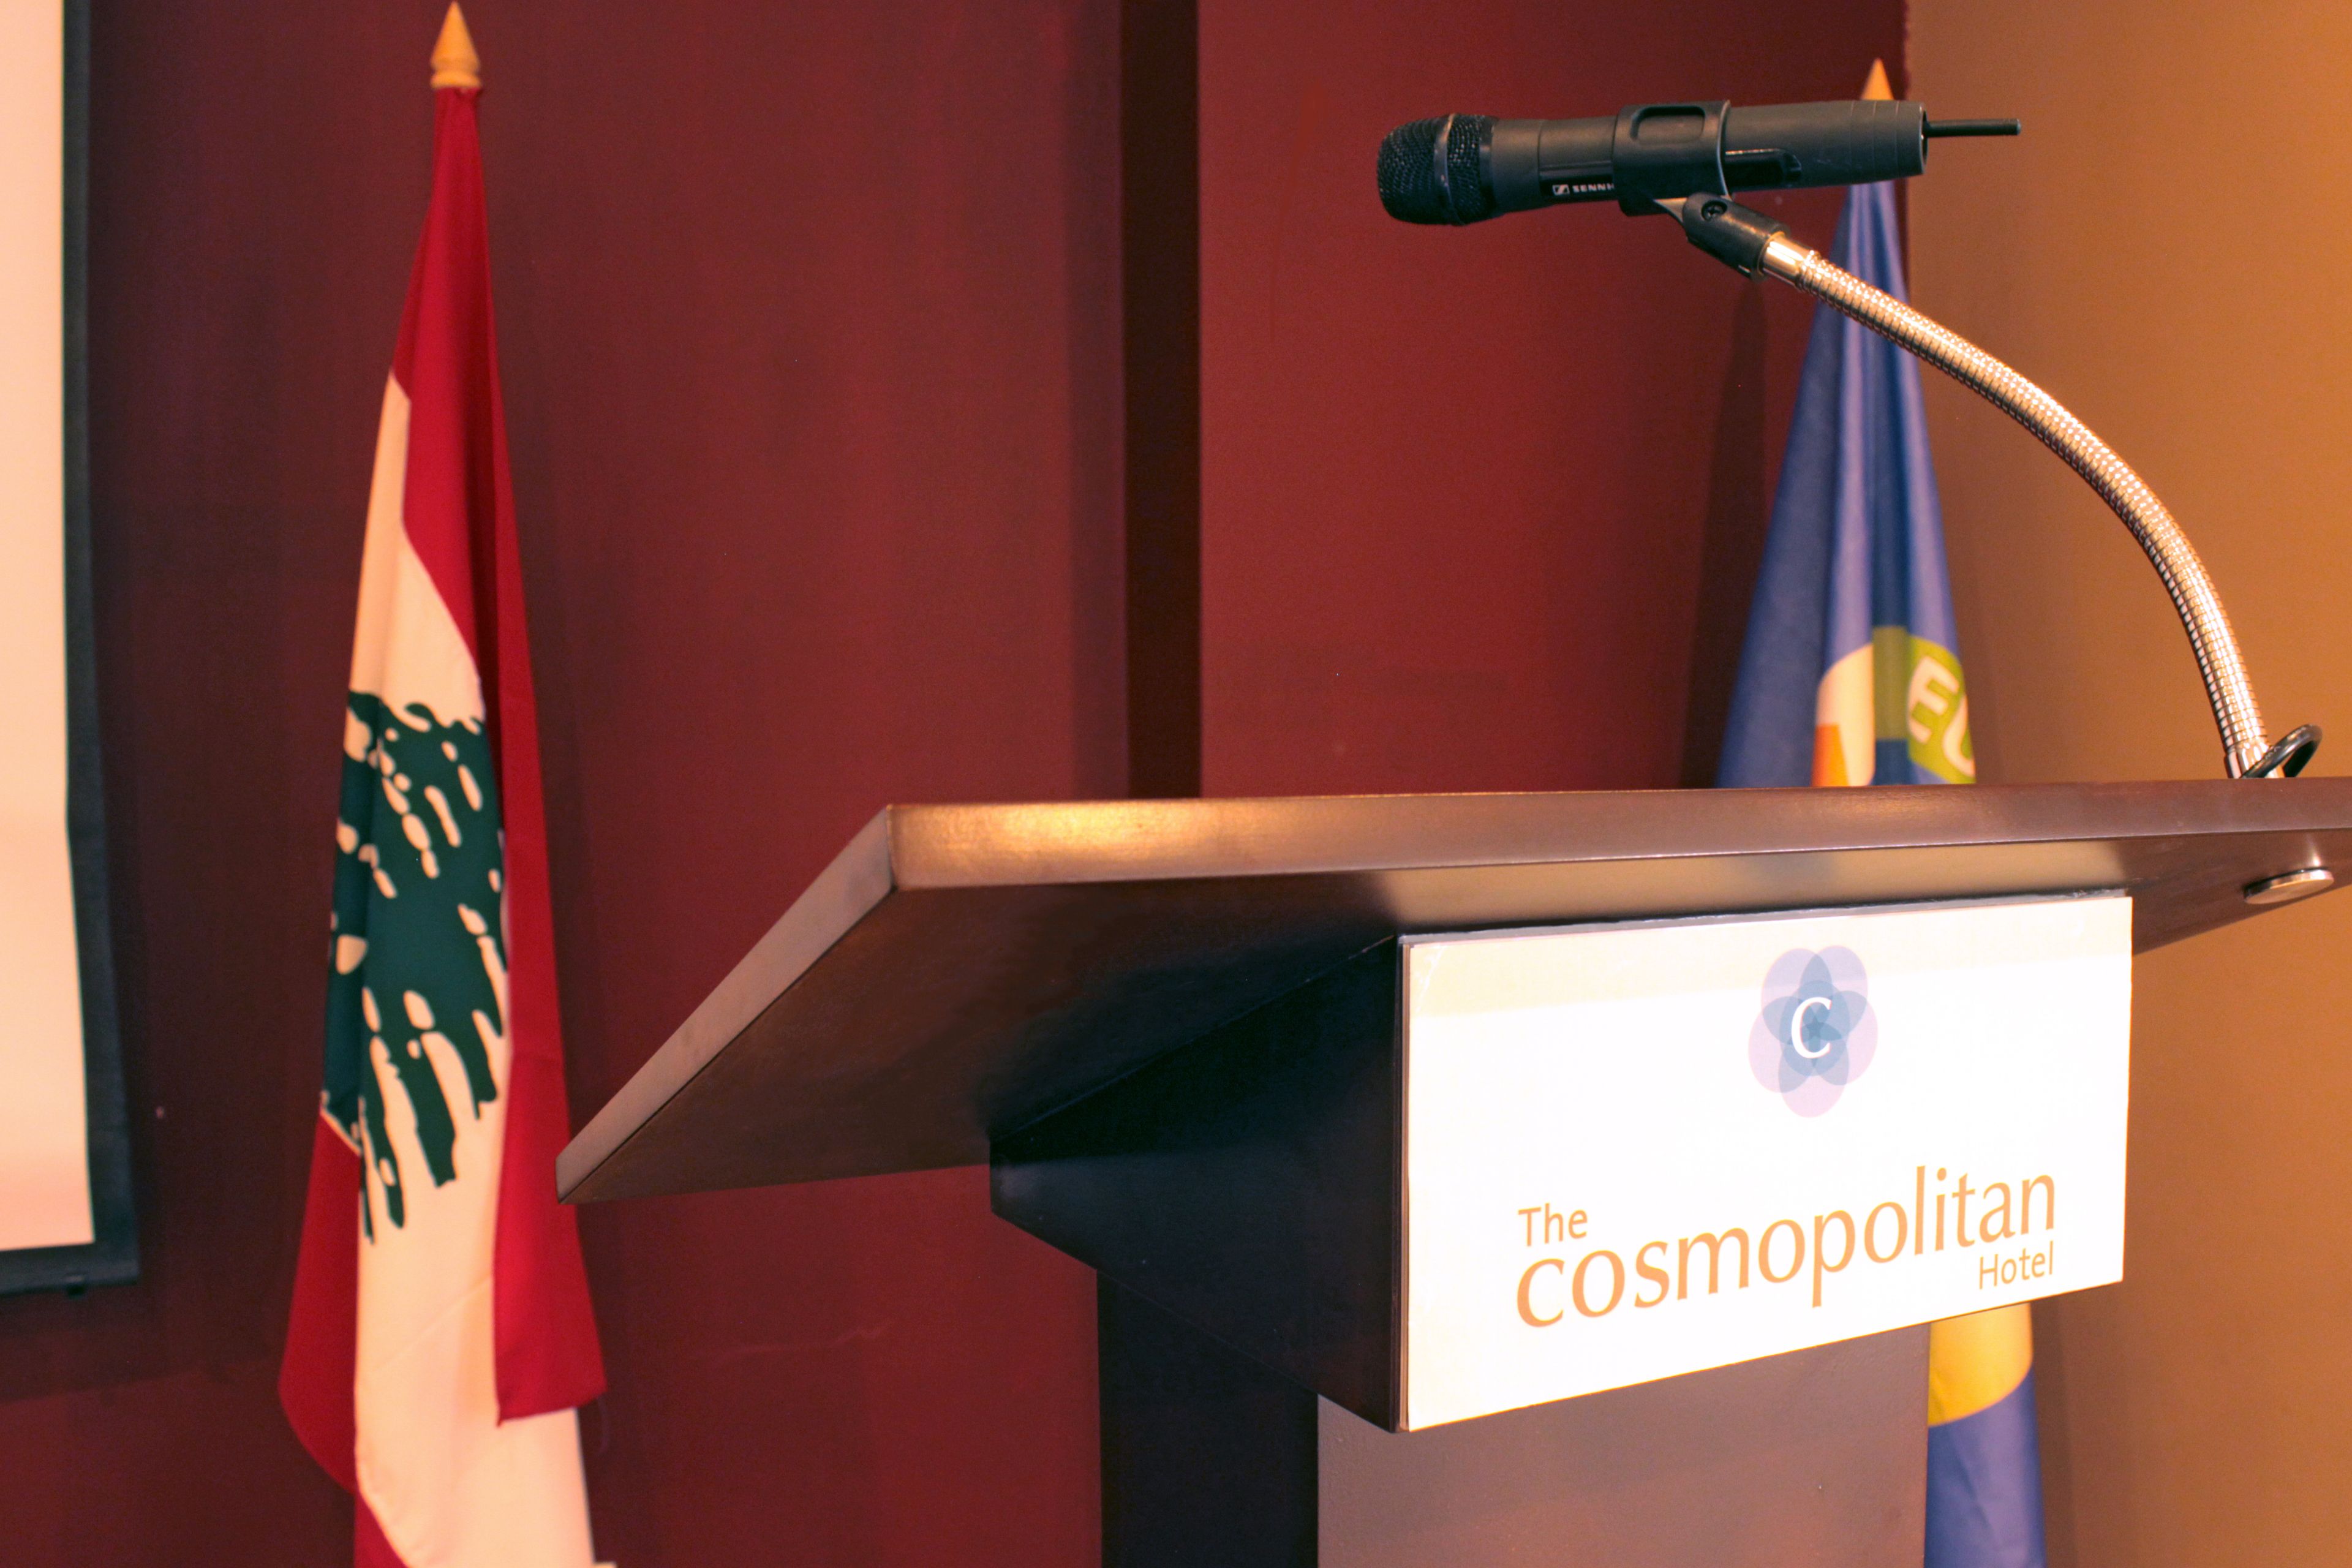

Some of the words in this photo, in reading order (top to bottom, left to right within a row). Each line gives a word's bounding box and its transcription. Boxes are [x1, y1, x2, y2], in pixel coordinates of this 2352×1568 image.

[1516, 1164, 2056, 1329] cosmopolitan
[1517, 1202, 1589, 1248] The
[1978, 1239, 2056, 1291] Hotel
